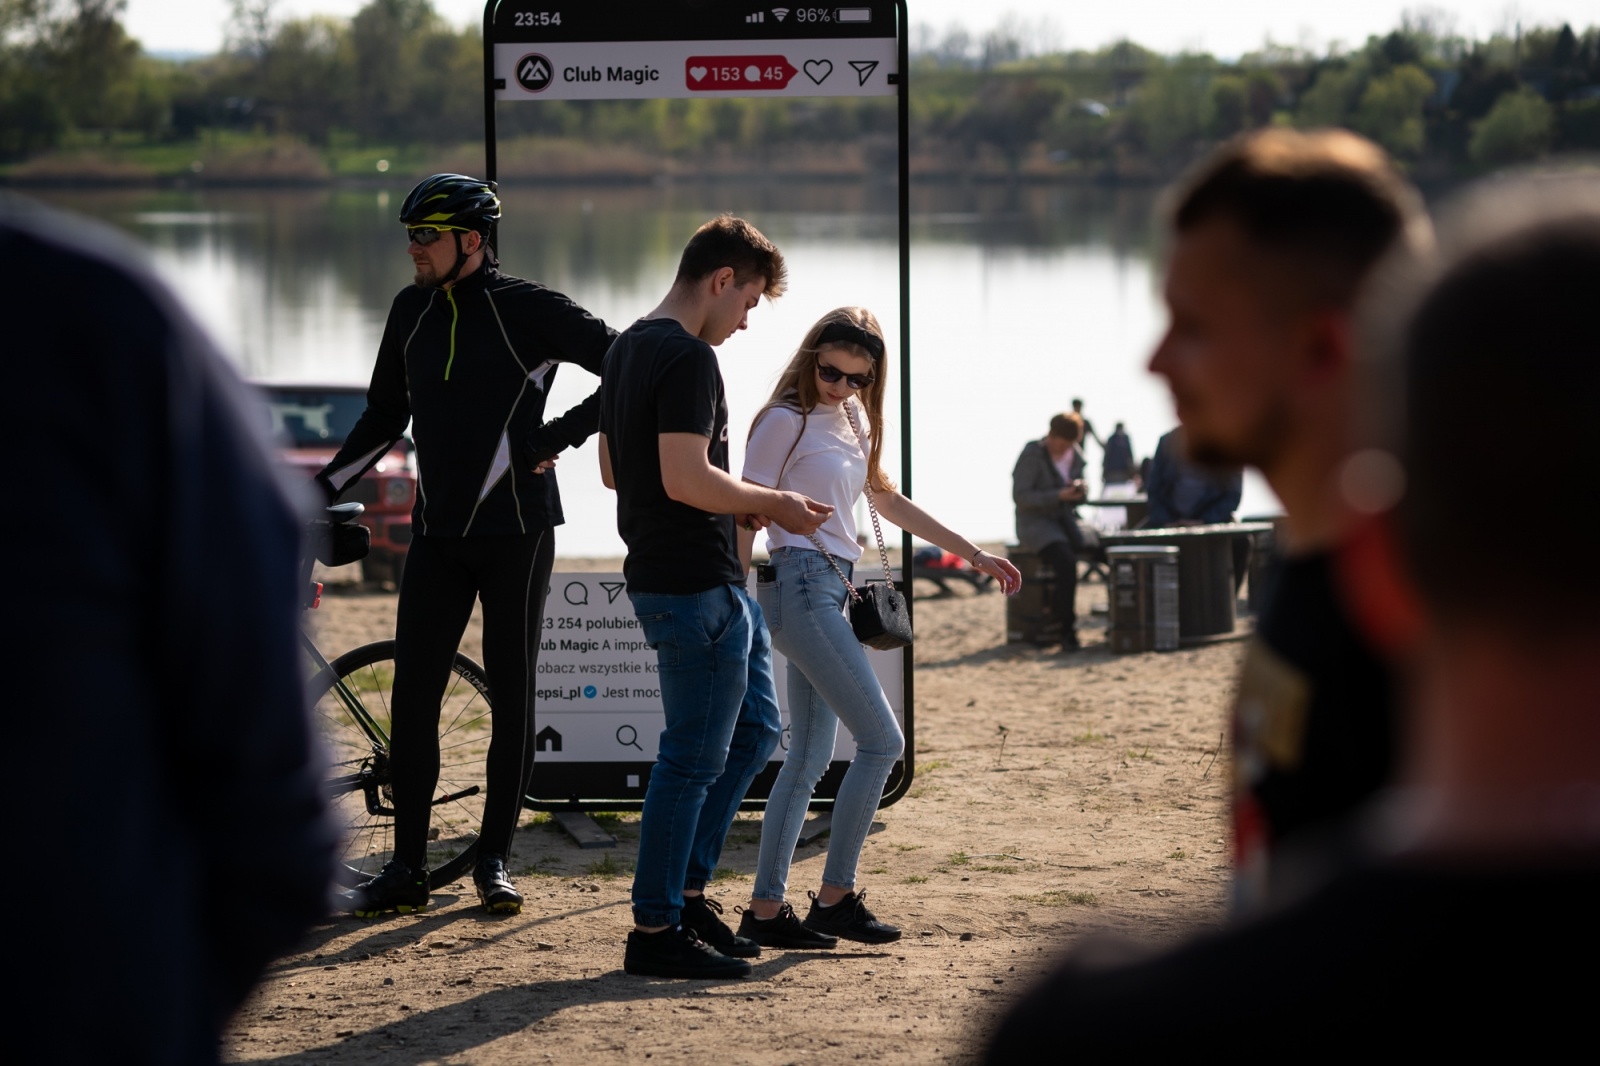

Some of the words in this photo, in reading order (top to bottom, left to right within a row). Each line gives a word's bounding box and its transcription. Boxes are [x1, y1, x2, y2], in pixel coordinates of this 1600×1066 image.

[514, 11, 562, 27] 23:54
[796, 7, 831, 23] 96%
[563, 66, 602, 82] Club
[607, 65, 660, 85] Magic
[711, 66, 740, 81] 153
[763, 66, 784, 80] 45
[557, 617, 582, 630] 254
[539, 639, 557, 651] ub
[560, 638, 599, 653] Magic
[602, 639, 611, 651] A
[614, 638, 655, 653] impre
[536, 661, 576, 674] obacz
[579, 661, 642, 676] wszystkie
[535, 685, 581, 701] epsi_pl
[602, 686, 629, 699] Jest
[633, 687, 661, 699] moc
